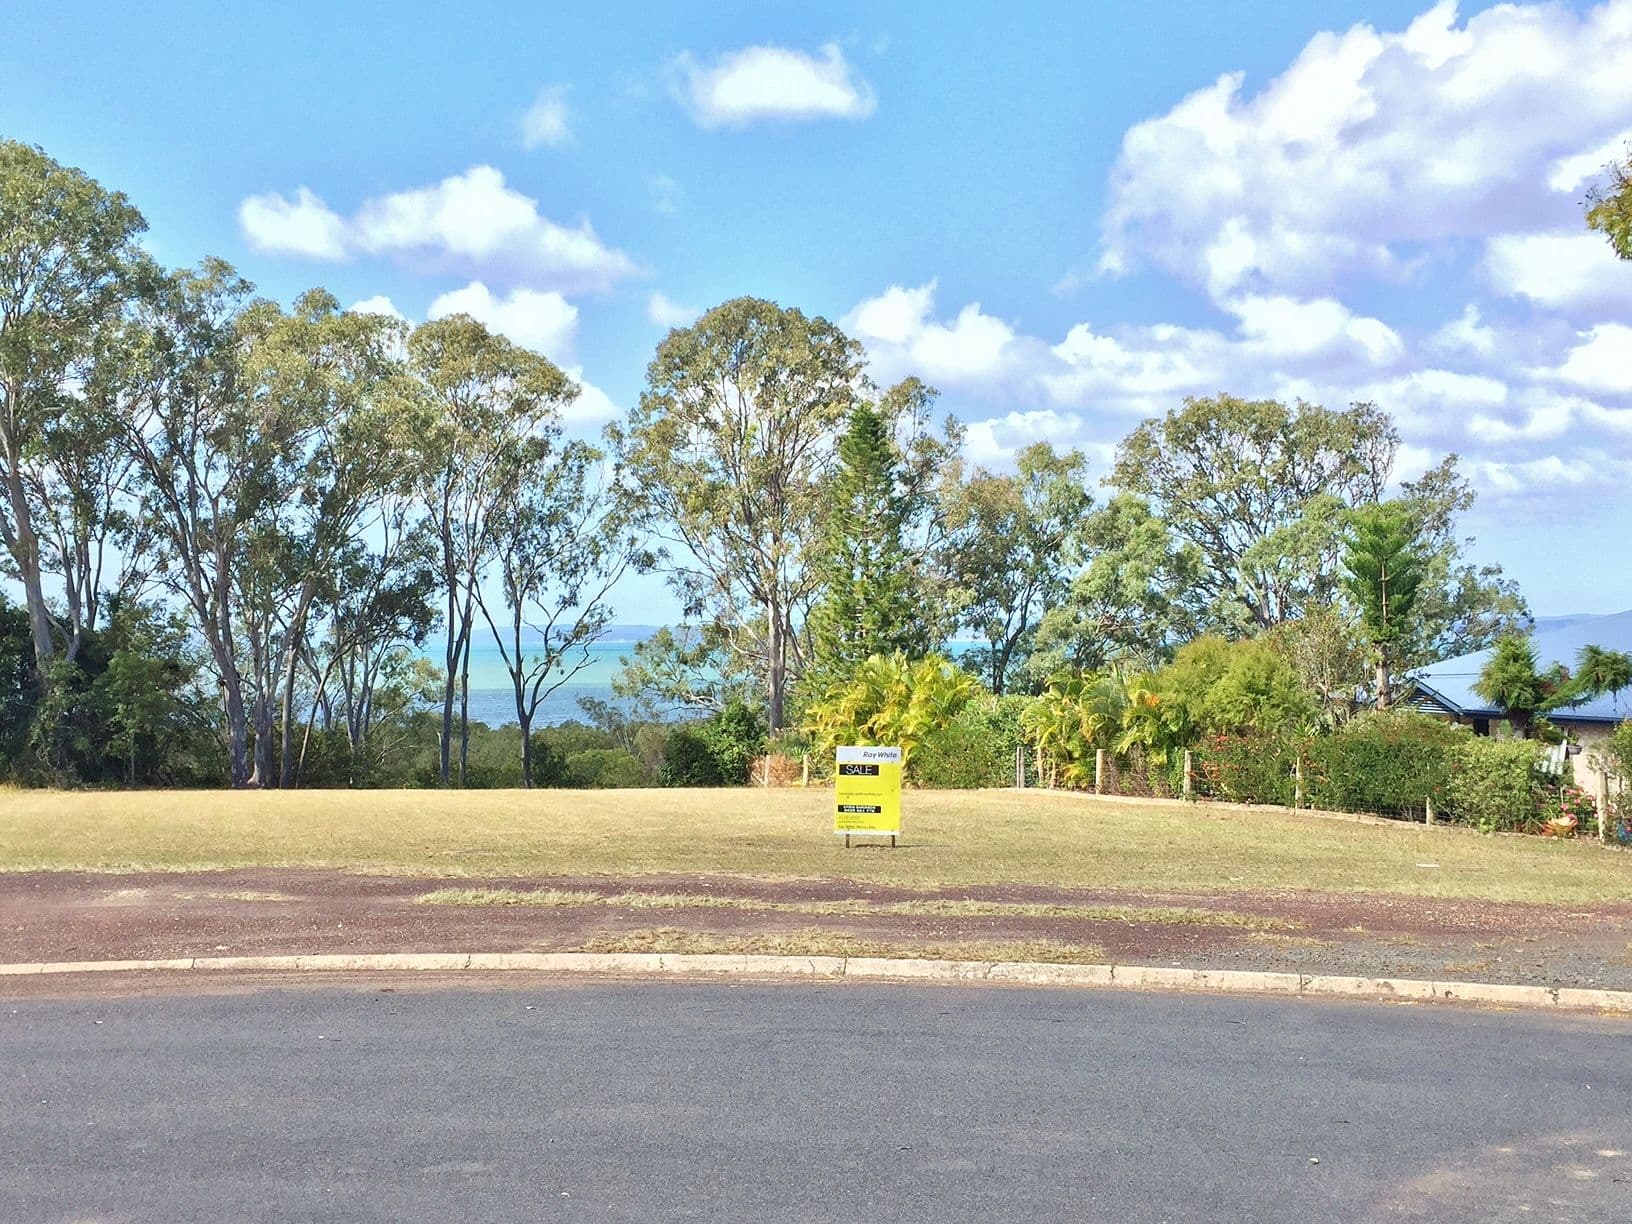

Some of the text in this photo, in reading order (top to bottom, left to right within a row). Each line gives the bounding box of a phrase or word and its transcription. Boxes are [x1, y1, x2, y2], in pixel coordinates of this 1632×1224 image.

[862, 751, 898, 759] Ray White
[845, 764, 873, 775] SALE
